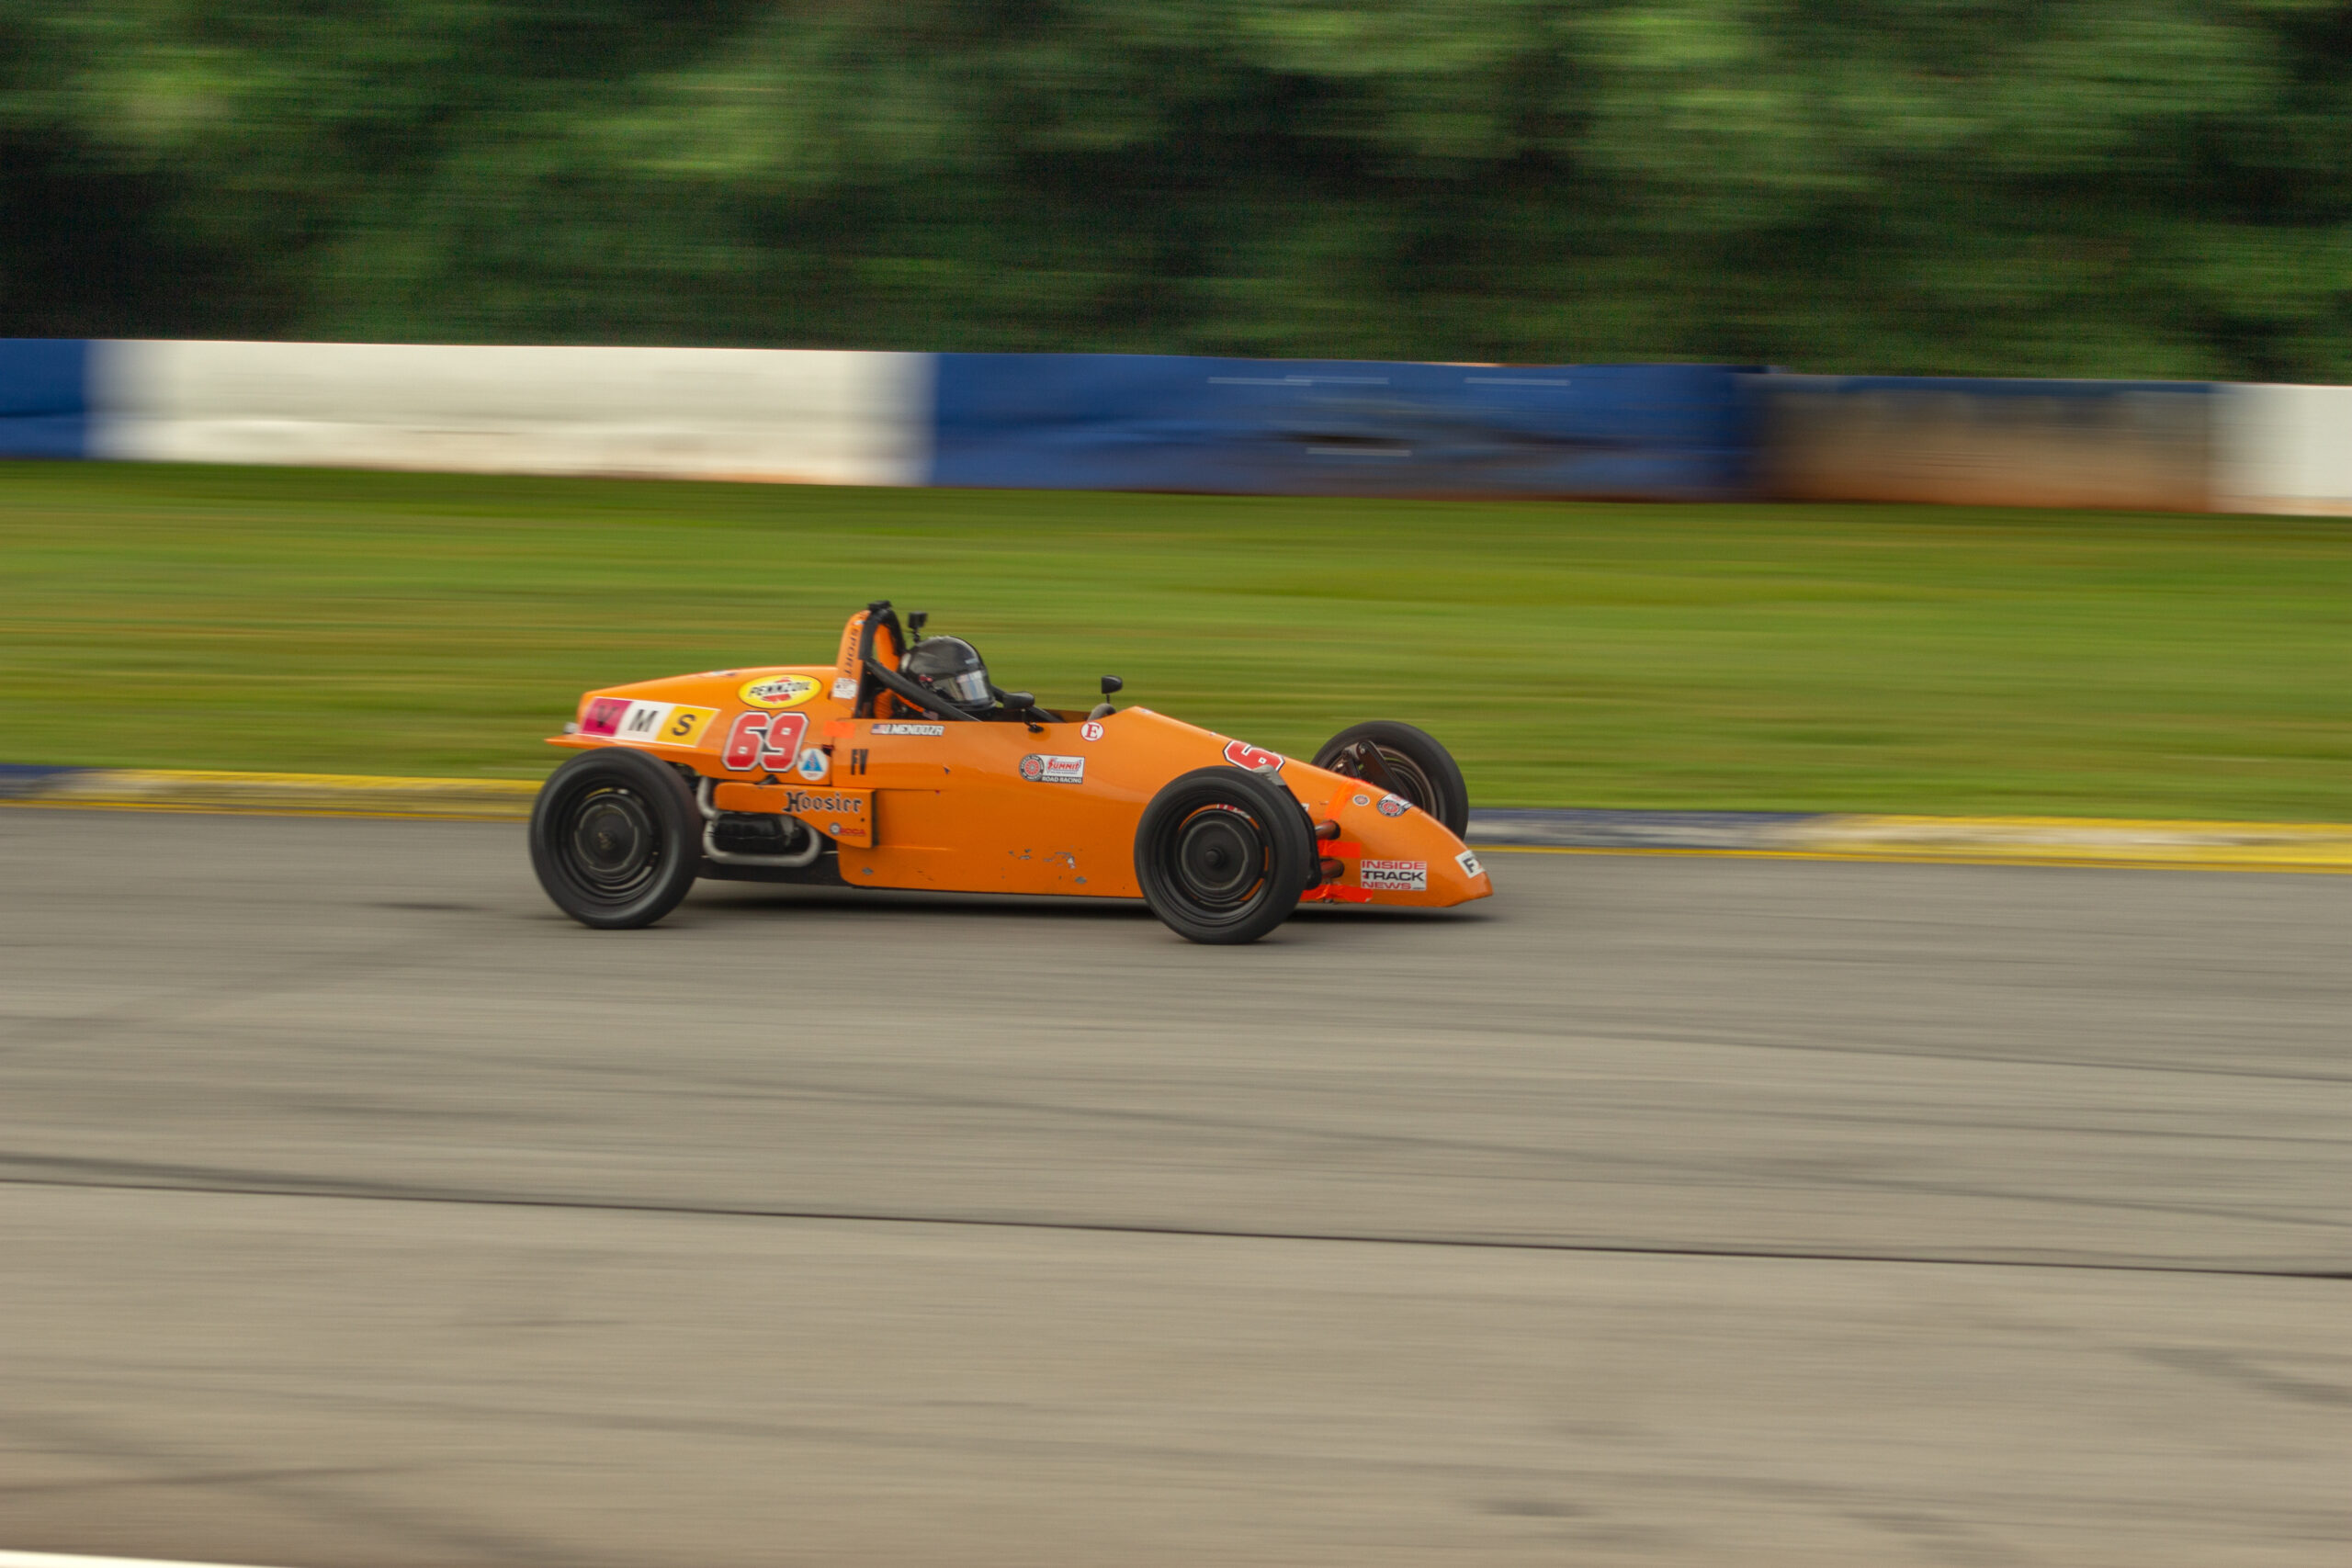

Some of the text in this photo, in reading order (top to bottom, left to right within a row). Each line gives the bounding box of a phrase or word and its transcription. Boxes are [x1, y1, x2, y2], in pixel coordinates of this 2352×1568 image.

[749, 681, 812, 697] PENNZOIL
[1085, 723, 1100, 739] E
[721, 710, 810, 773] 69
[851, 749, 869, 775] FV
[782, 791, 863, 813] Hoosier
[1362, 860, 1426, 870] INSIDE
[1362, 870, 1425, 882] TRACK
[1362, 881, 1412, 890] NEWS
